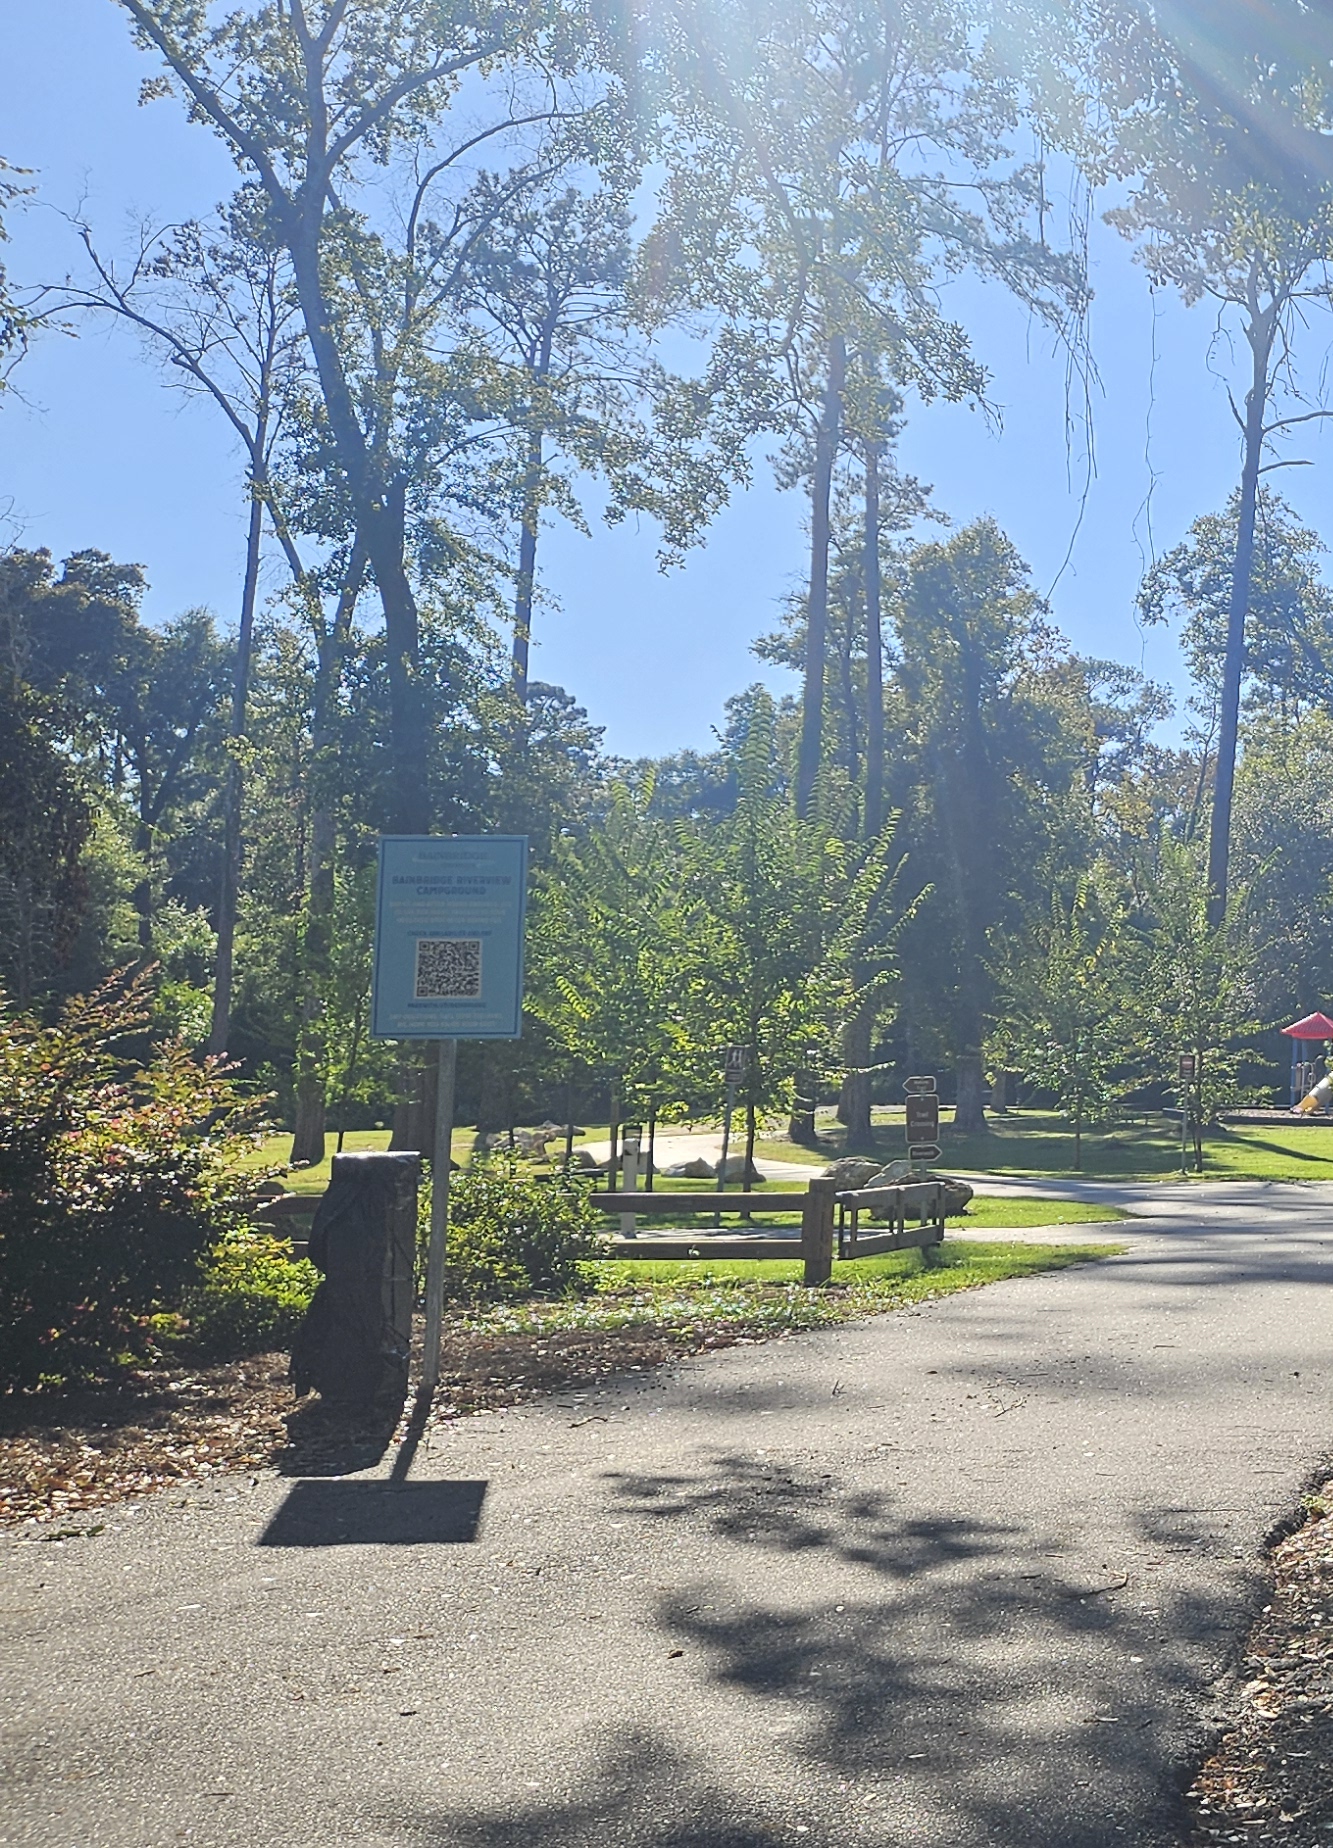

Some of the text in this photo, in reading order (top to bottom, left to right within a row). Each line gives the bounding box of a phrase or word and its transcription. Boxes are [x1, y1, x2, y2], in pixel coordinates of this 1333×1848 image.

[392, 875, 512, 885] BAINBRIDGE RIVERVIEW
[416, 886, 487, 895] CAMPGROUND
[910, 1120, 935, 1128] Crossing
